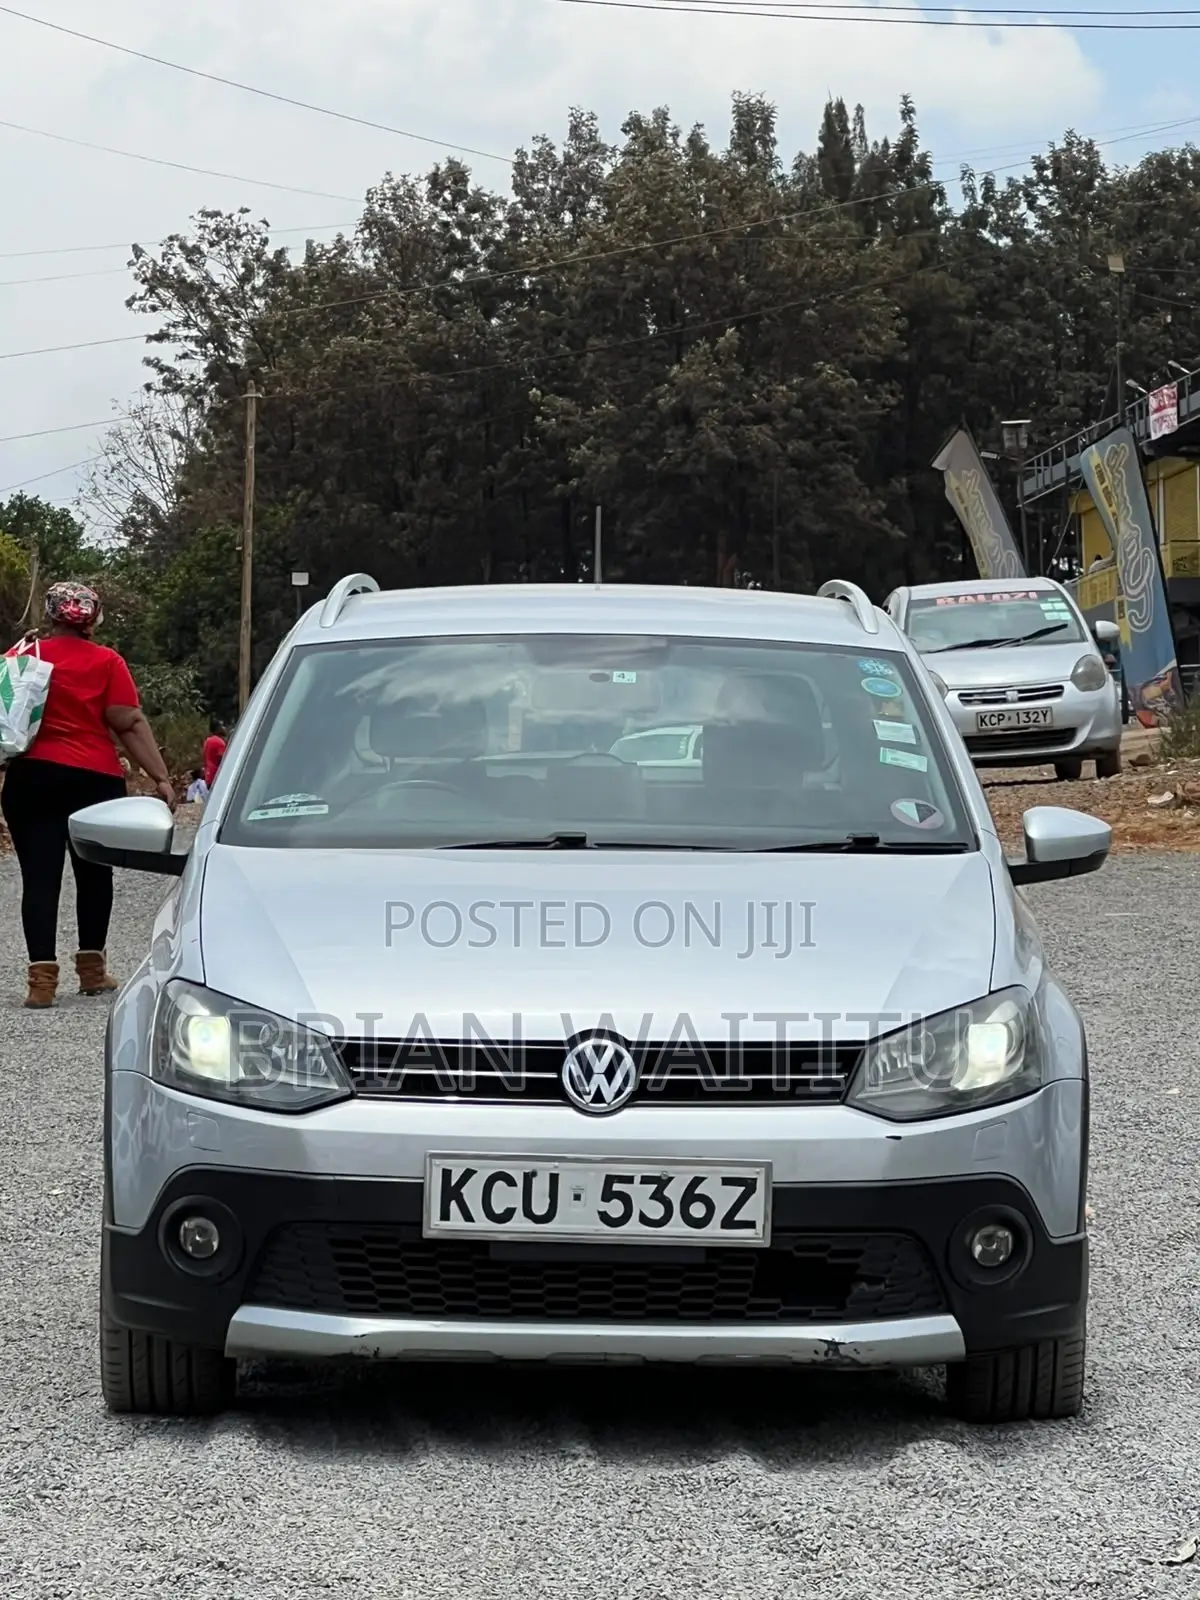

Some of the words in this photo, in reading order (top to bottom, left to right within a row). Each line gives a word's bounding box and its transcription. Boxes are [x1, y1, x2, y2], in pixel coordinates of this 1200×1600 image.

[979, 712, 1006, 727] KCP
[1015, 709, 1049, 725] 132Y
[439, 1167, 560, 1225] KCU
[596, 1173, 758, 1230] 536Z
